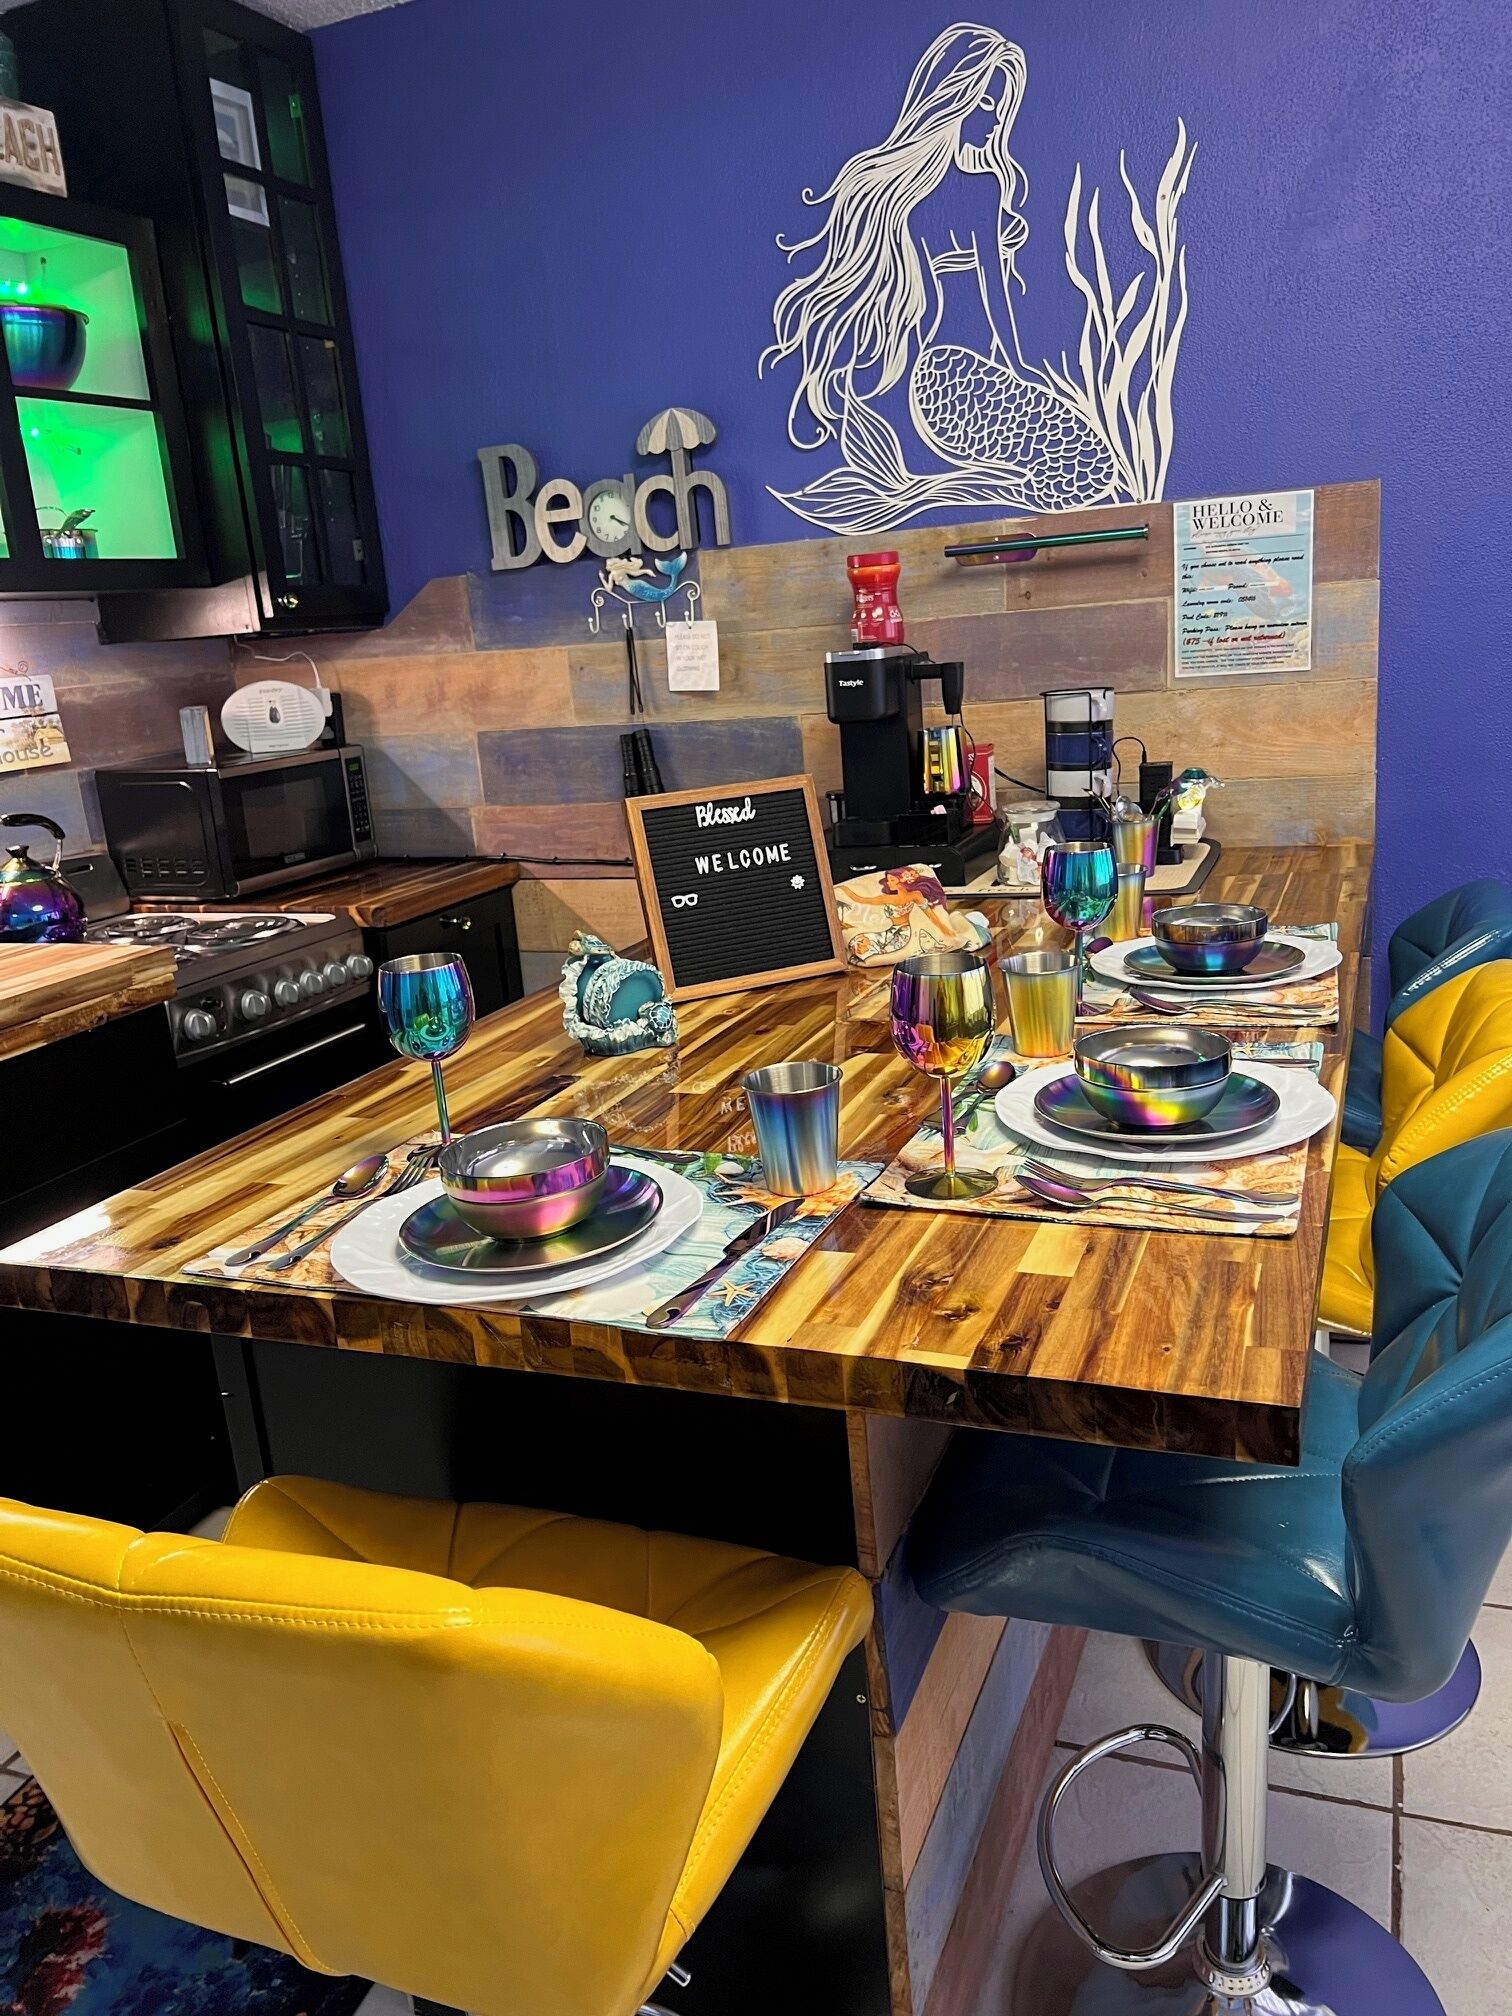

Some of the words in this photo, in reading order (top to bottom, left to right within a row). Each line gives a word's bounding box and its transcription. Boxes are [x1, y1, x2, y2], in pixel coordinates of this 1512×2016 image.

[0, 111, 61, 176] ACH
[477, 438, 731, 571] Beach
[1193, 500, 1252, 518] HELLO
[1258, 498, 1273, 512] &
[1192, 510, 1284, 530] WELCOME
[838, 679, 864, 688] Tastyle
[0, 684, 43, 710] ME
[0, 744, 54, 764] ouse
[694, 796, 757, 828] Blessed
[694, 843, 792, 875] WELCOME
